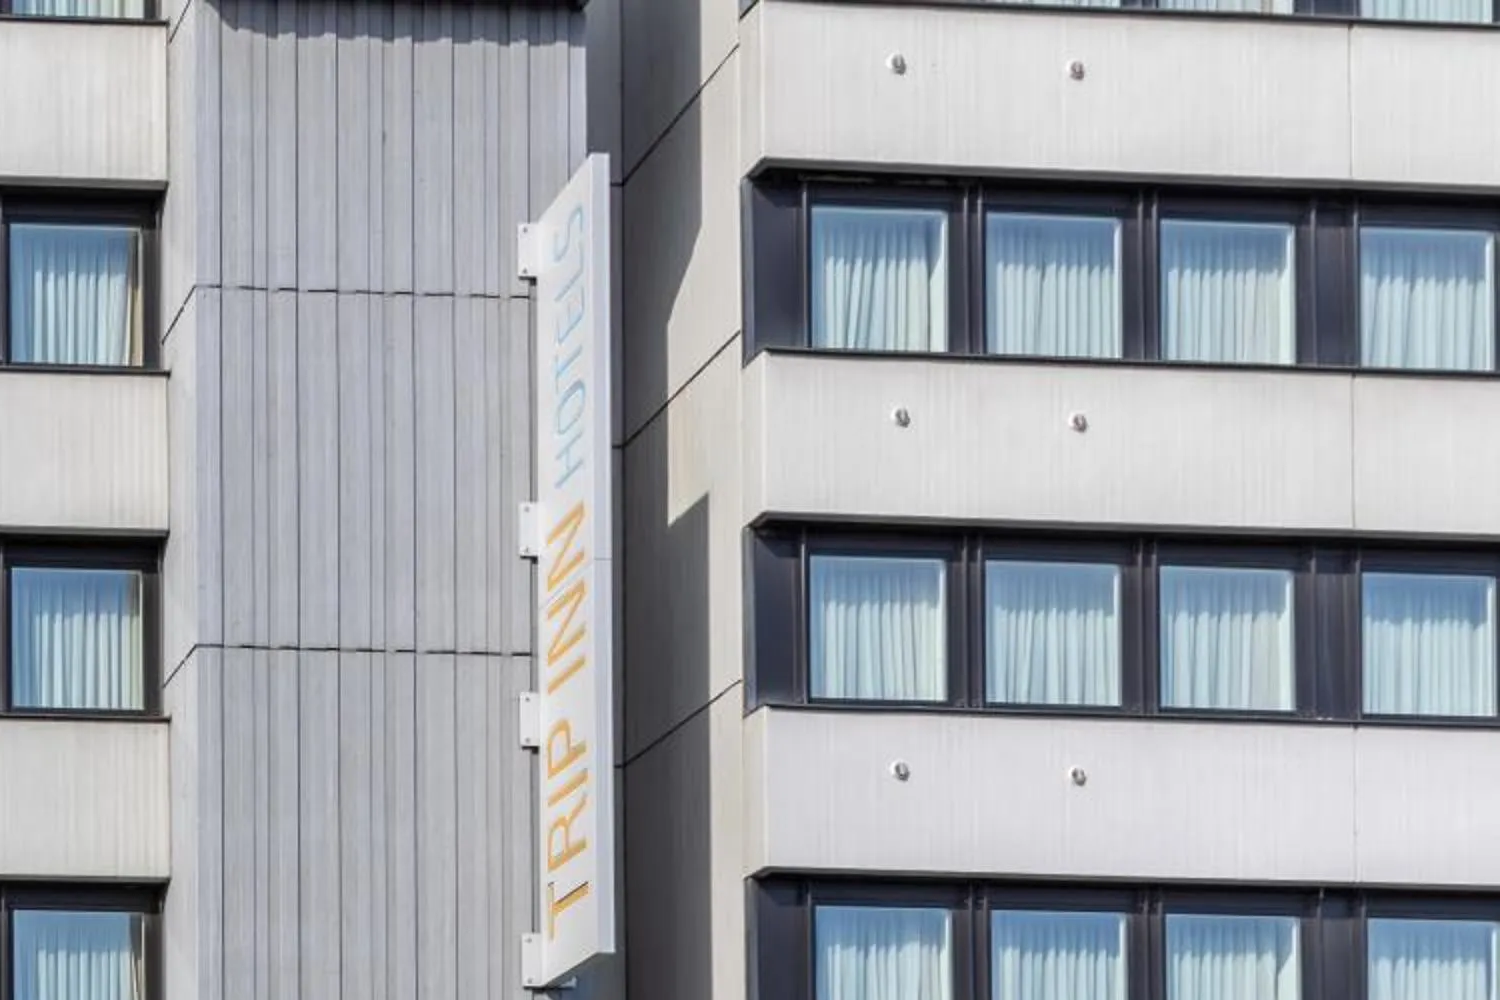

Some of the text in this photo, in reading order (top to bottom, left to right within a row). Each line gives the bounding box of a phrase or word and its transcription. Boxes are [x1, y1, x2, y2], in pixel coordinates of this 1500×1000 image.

[546, 204, 590, 941] TRIP INN HOTELS
